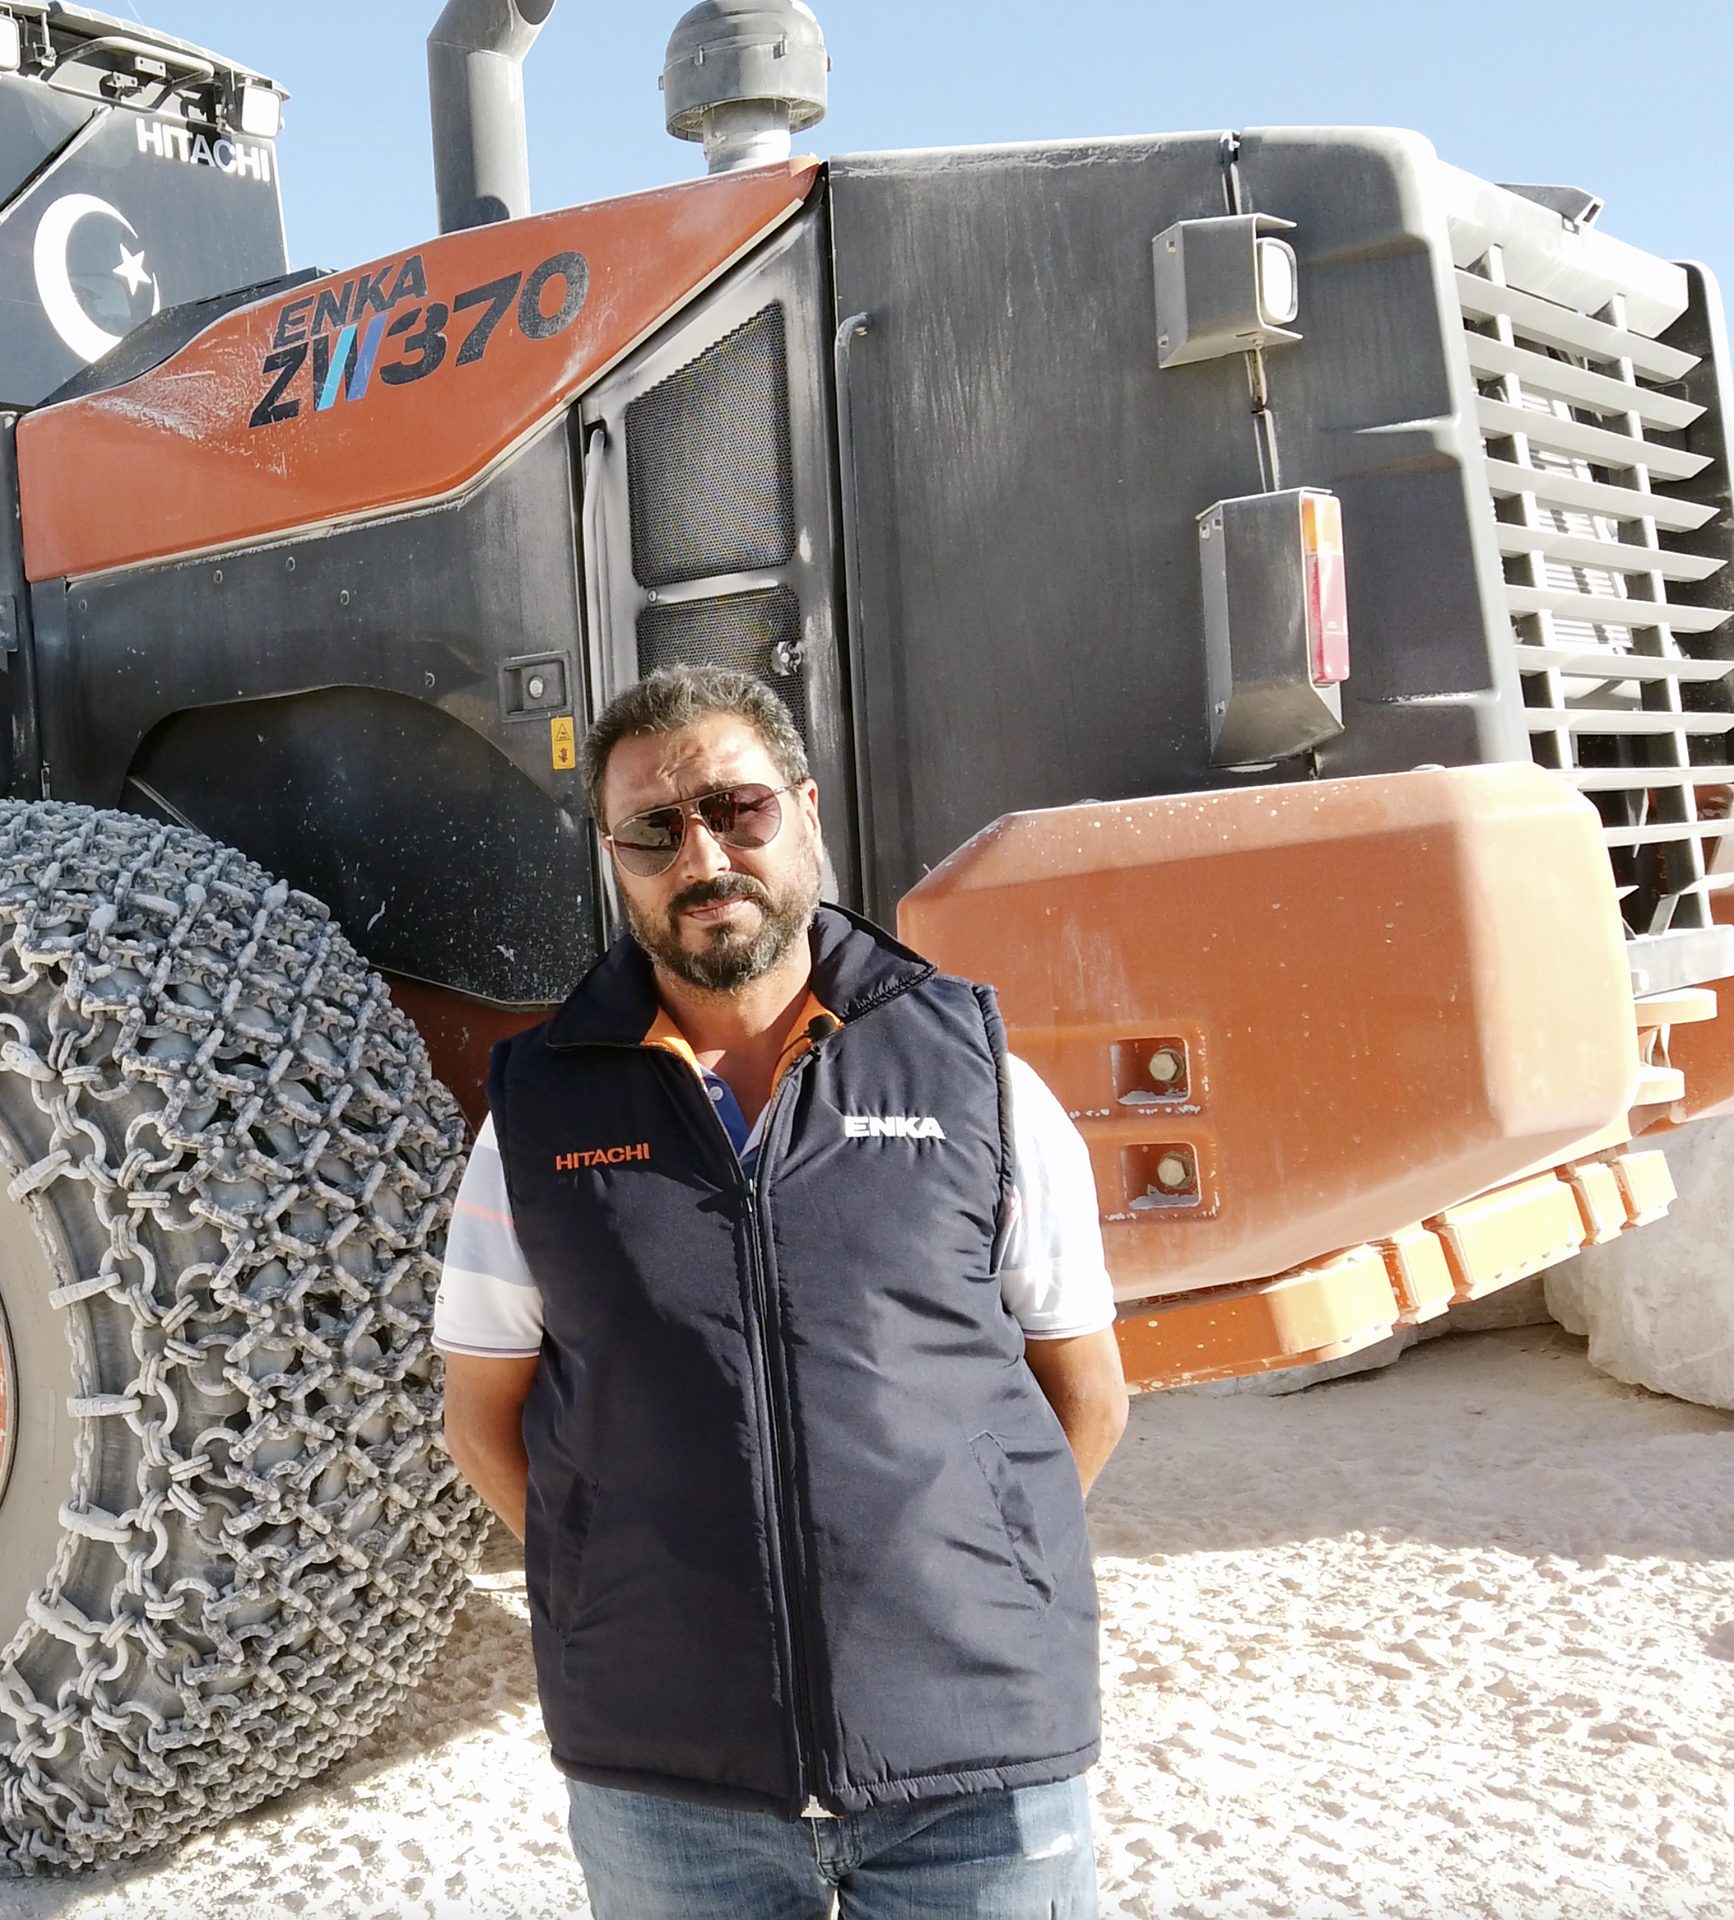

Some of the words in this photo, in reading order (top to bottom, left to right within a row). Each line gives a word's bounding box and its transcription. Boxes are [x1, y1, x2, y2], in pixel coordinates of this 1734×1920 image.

[135, 117, 271, 182] HITACHI
[272, 254, 428, 350] ENKA
[844, 1115, 946, 1140] ENKA
[555, 1142, 651, 1171] HITACHI
